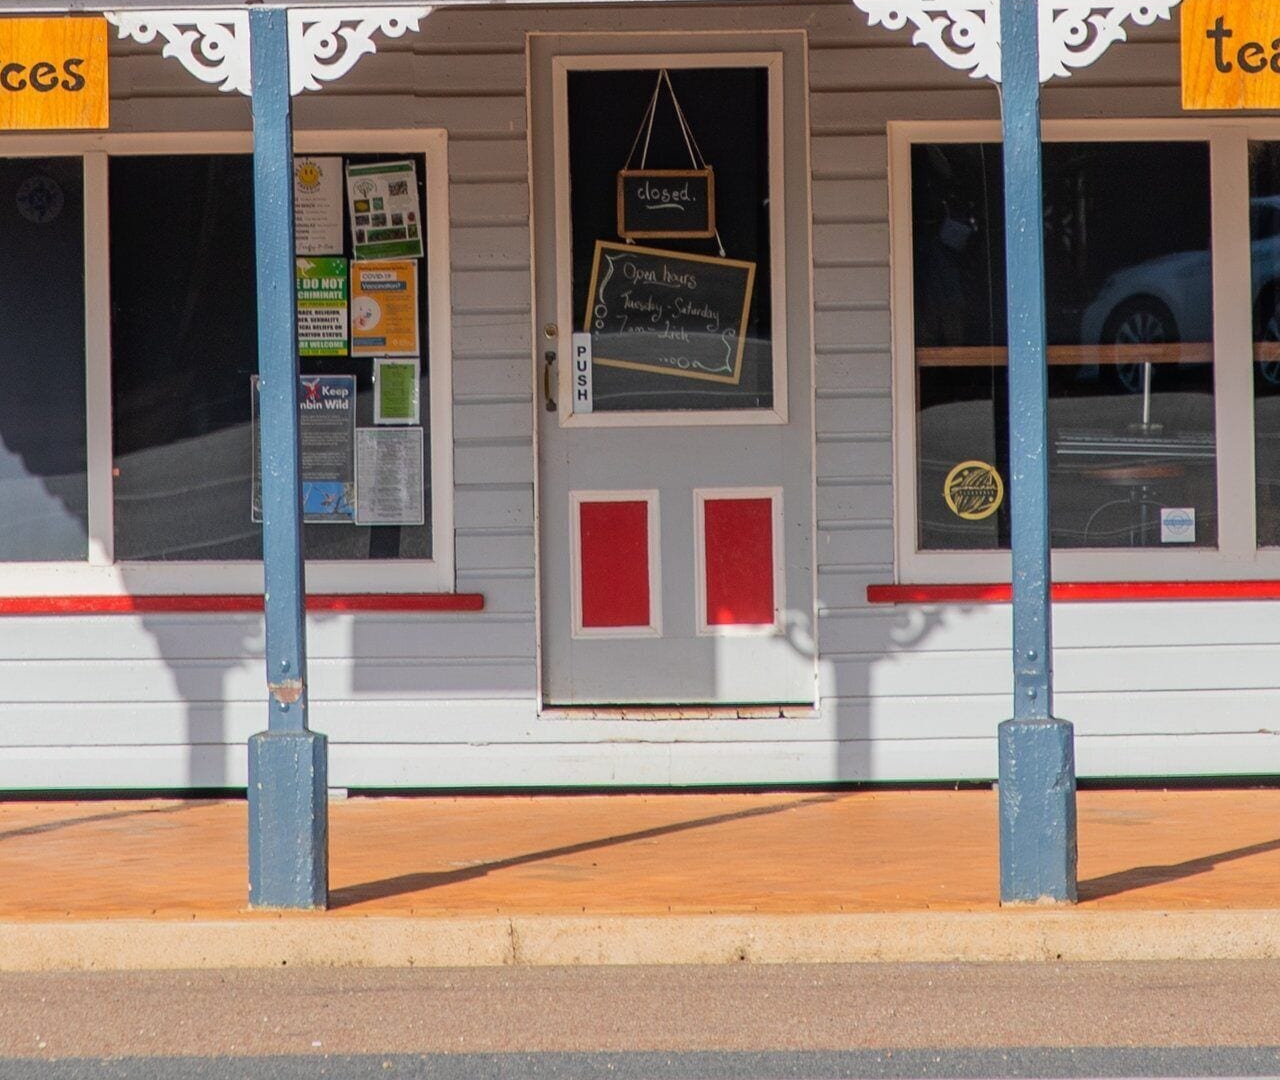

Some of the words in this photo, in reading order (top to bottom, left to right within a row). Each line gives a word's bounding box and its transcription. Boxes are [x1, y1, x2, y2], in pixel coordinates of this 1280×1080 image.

[623, 261, 657, 286] Open
[663, 263, 697, 290] hours
[303, 278, 319, 289] DO
[322, 278, 344, 289] NOT
[298, 291, 343, 300] CRIMINATE
[620, 290, 662, 322] Tuesday
[672, 297, 720, 332] Saturday
[576, 346, 588, 401] PUSH
[322, 386, 349, 398] Keep
[324, 398, 349, 409] Wild
